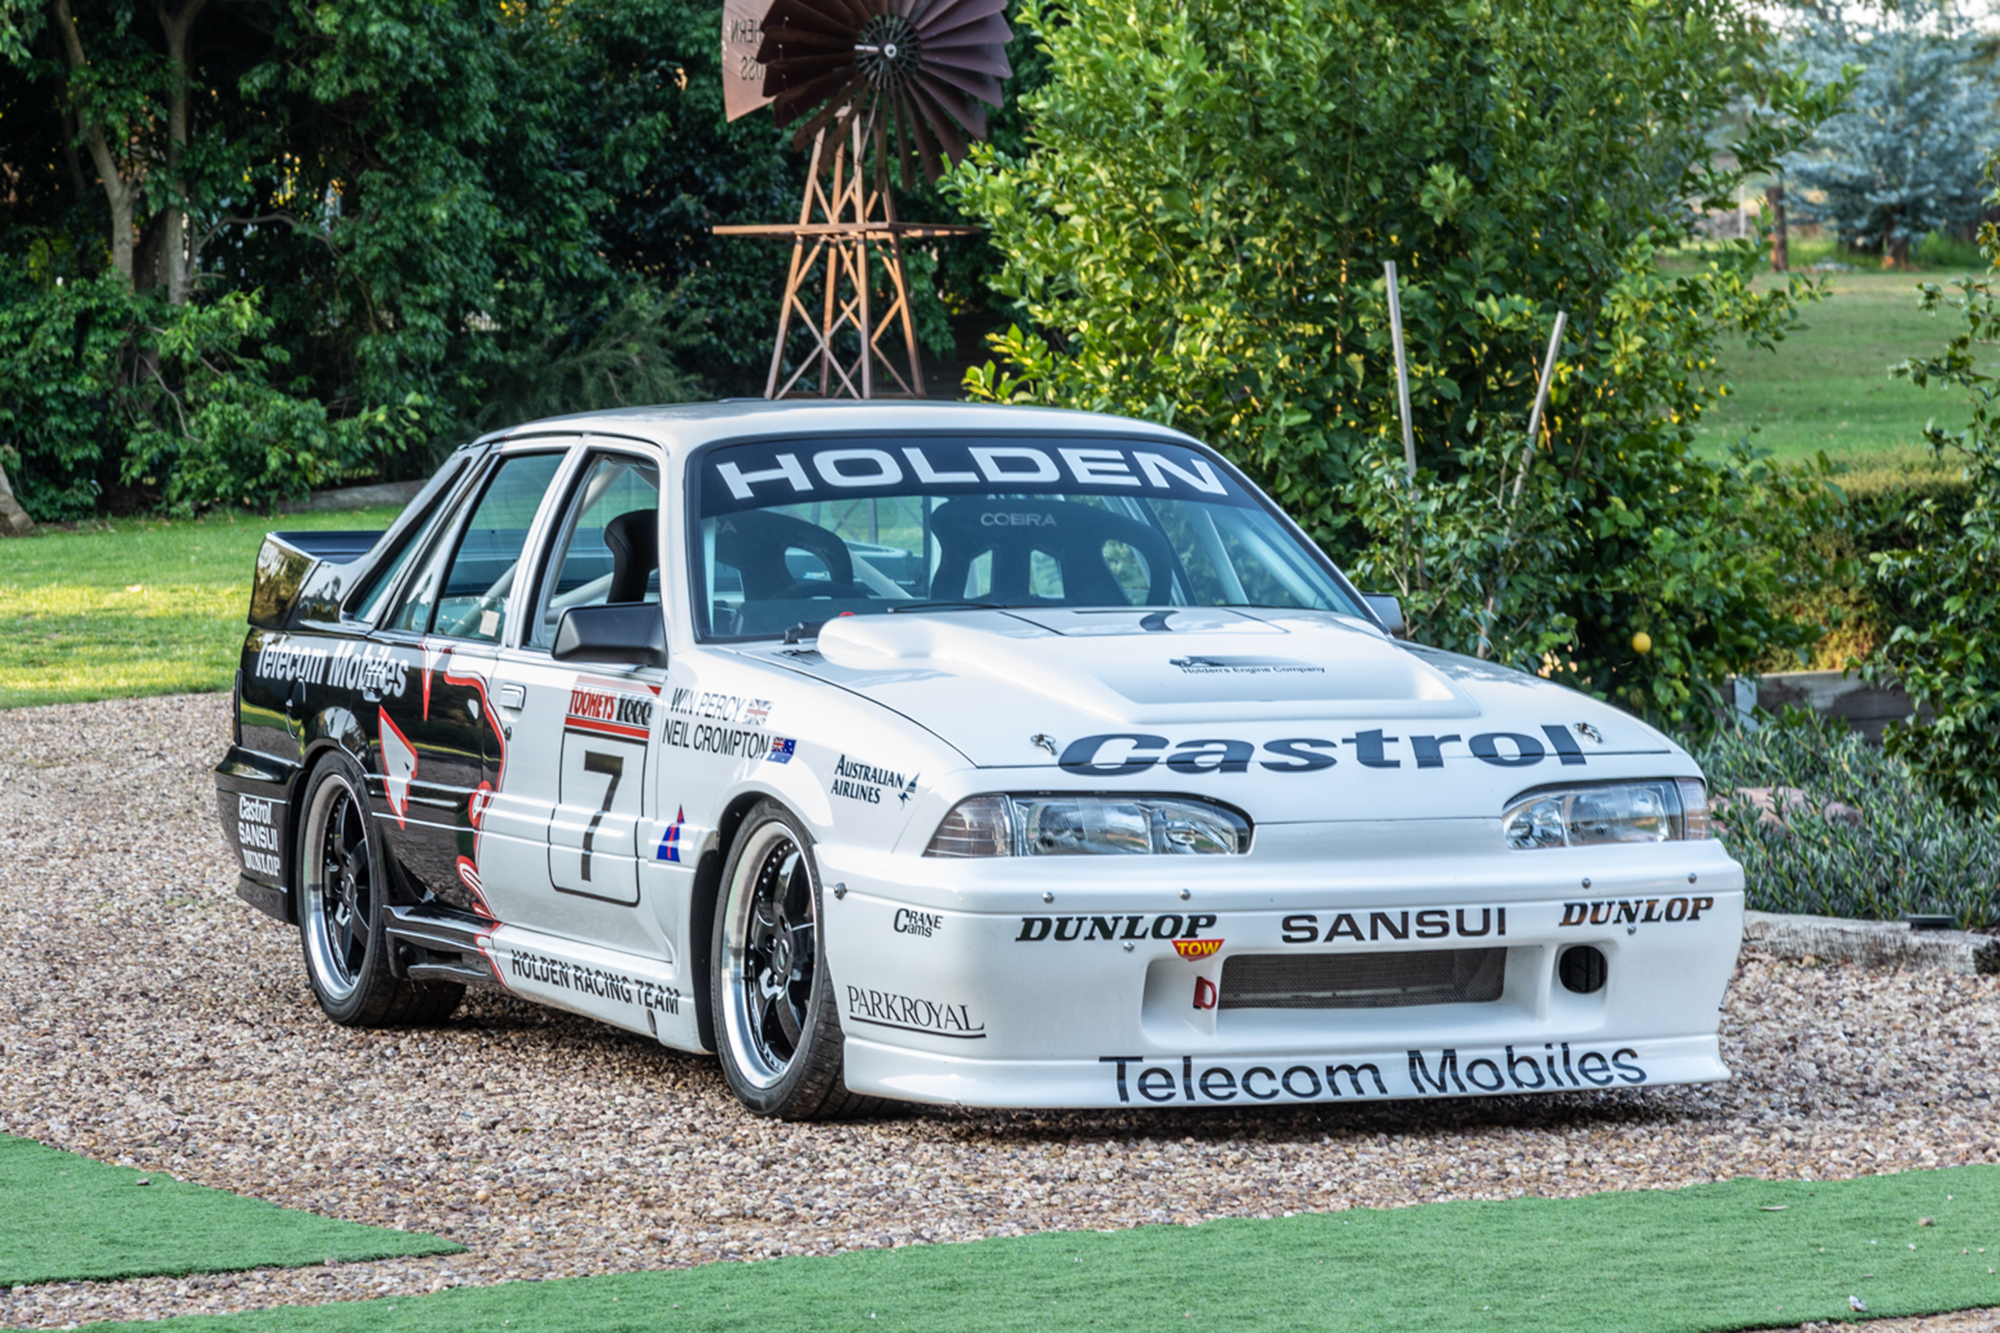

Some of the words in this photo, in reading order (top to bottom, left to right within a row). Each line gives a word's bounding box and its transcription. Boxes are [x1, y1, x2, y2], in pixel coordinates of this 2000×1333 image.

[716, 446, 1228, 500] HOLDEN
[980, 512, 1058, 527] COBRA
[255, 632, 328, 685] Telecom
[326, 640, 410, 698] Mobiles
[1231, 666, 1272, 675] Engine
[1272, 665, 1326, 675] Company
[568, 689, 618, 721] TOOHEYS
[616, 696, 654, 726] 1000
[670, 687, 697, 715] WIN
[697, 690, 747, 723] PERCY
[662, 718, 691, 749] NEIL
[693, 724, 771, 760] CROMPTON
[1057, 724, 1588, 777] Castrol
[834, 753, 906, 789] AUSTRALIAN
[830, 778, 881, 805] AIRLINES
[239, 795, 272, 825] Castrol
[580, 749, 625, 883] 7
[238, 821, 279, 852] SANSUI
[242, 847, 281, 877] DUNLOP
[1014, 913, 1218, 942] DUNLOP
[1281, 906, 1506, 944] SANSUI
[1558, 896, 1715, 927] DUNLOP
[1176, 941, 1220, 956] TOW
[510, 949, 571, 989] HOLDEN
[573, 964, 633, 1005] RACING
[633, 979, 682, 1016] TEAM
[846, 984, 986, 1022] PARKROYAL
[1098, 1055, 1389, 1103] Telecom
[1406, 1041, 1648, 1094] Mobiles
